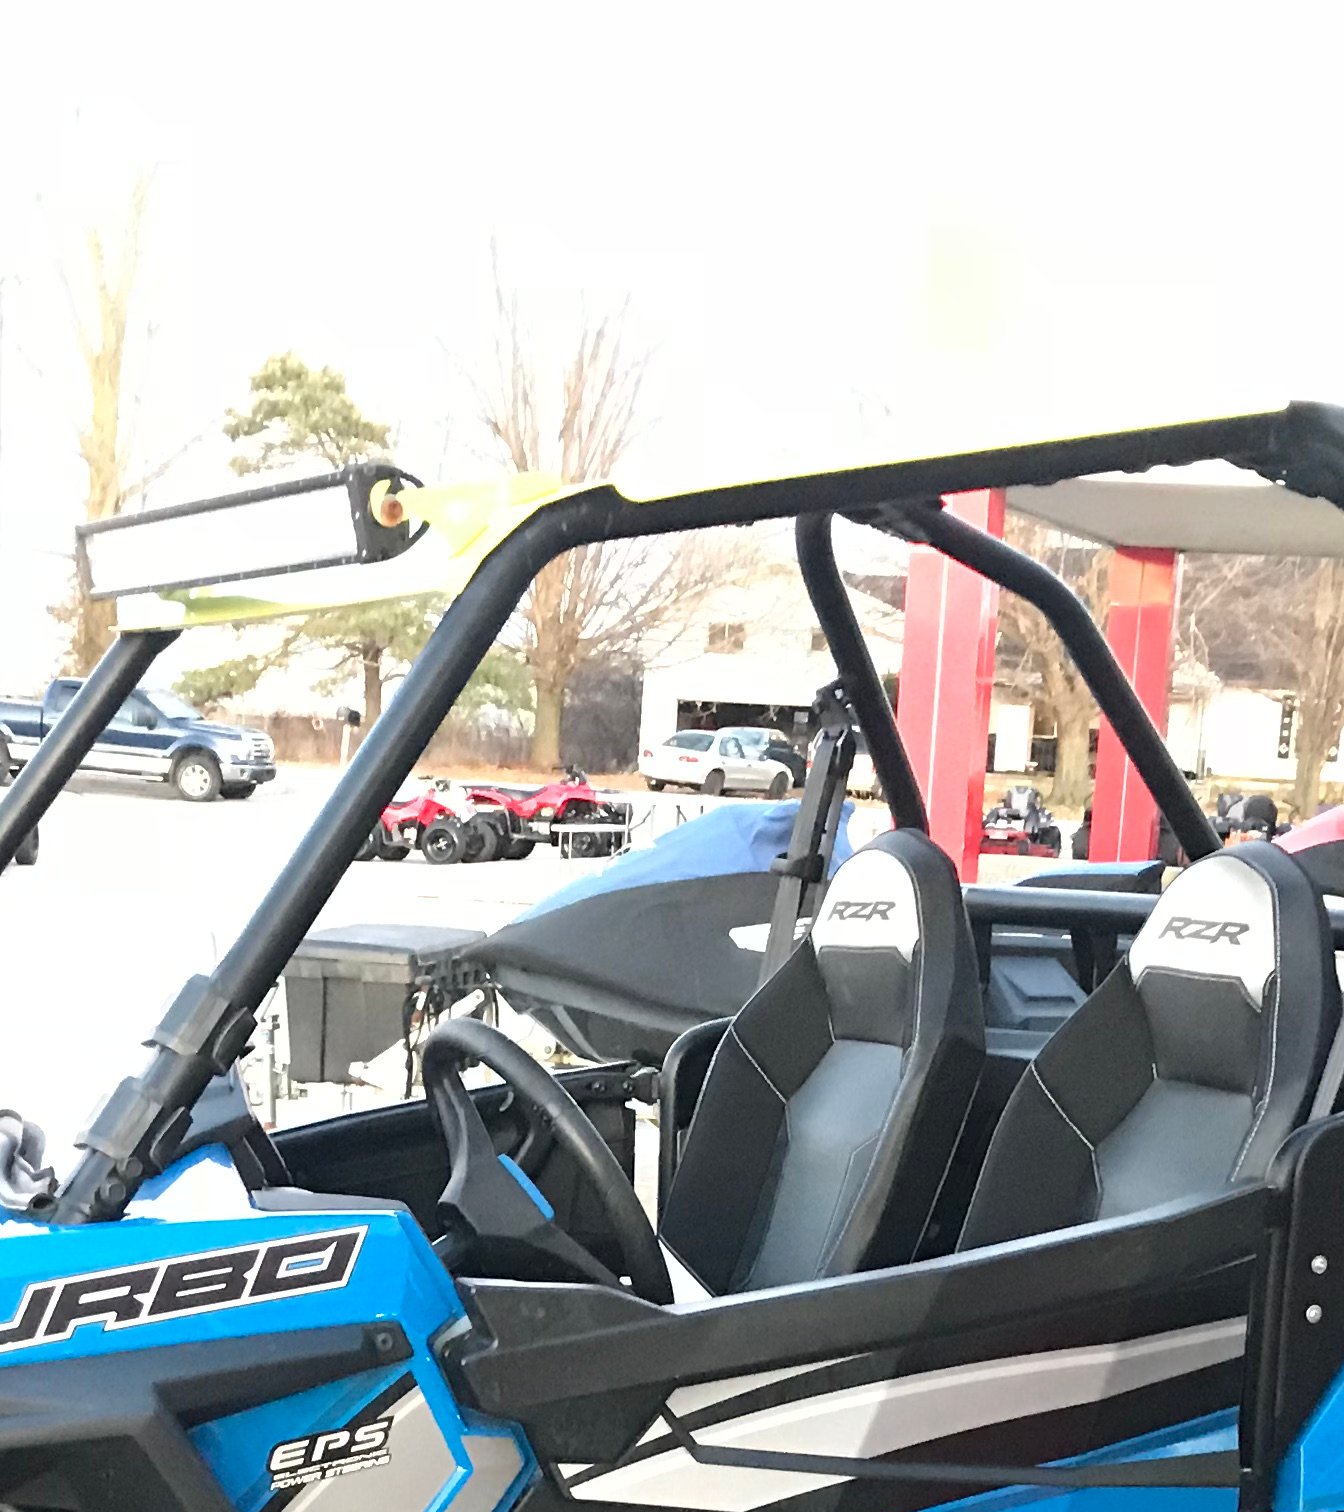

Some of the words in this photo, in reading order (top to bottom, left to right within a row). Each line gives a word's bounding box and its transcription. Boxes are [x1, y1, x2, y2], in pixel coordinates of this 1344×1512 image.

[827, 900, 896, 921] RZR
[1158, 916, 1250, 946] RZR
[270, 1421, 389, 1471] EPS
[270, 1471, 323, 1491] POWER
[325, 1455, 390, 1478] STEERING
[273, 1449, 388, 1481] ELECTRONIC
